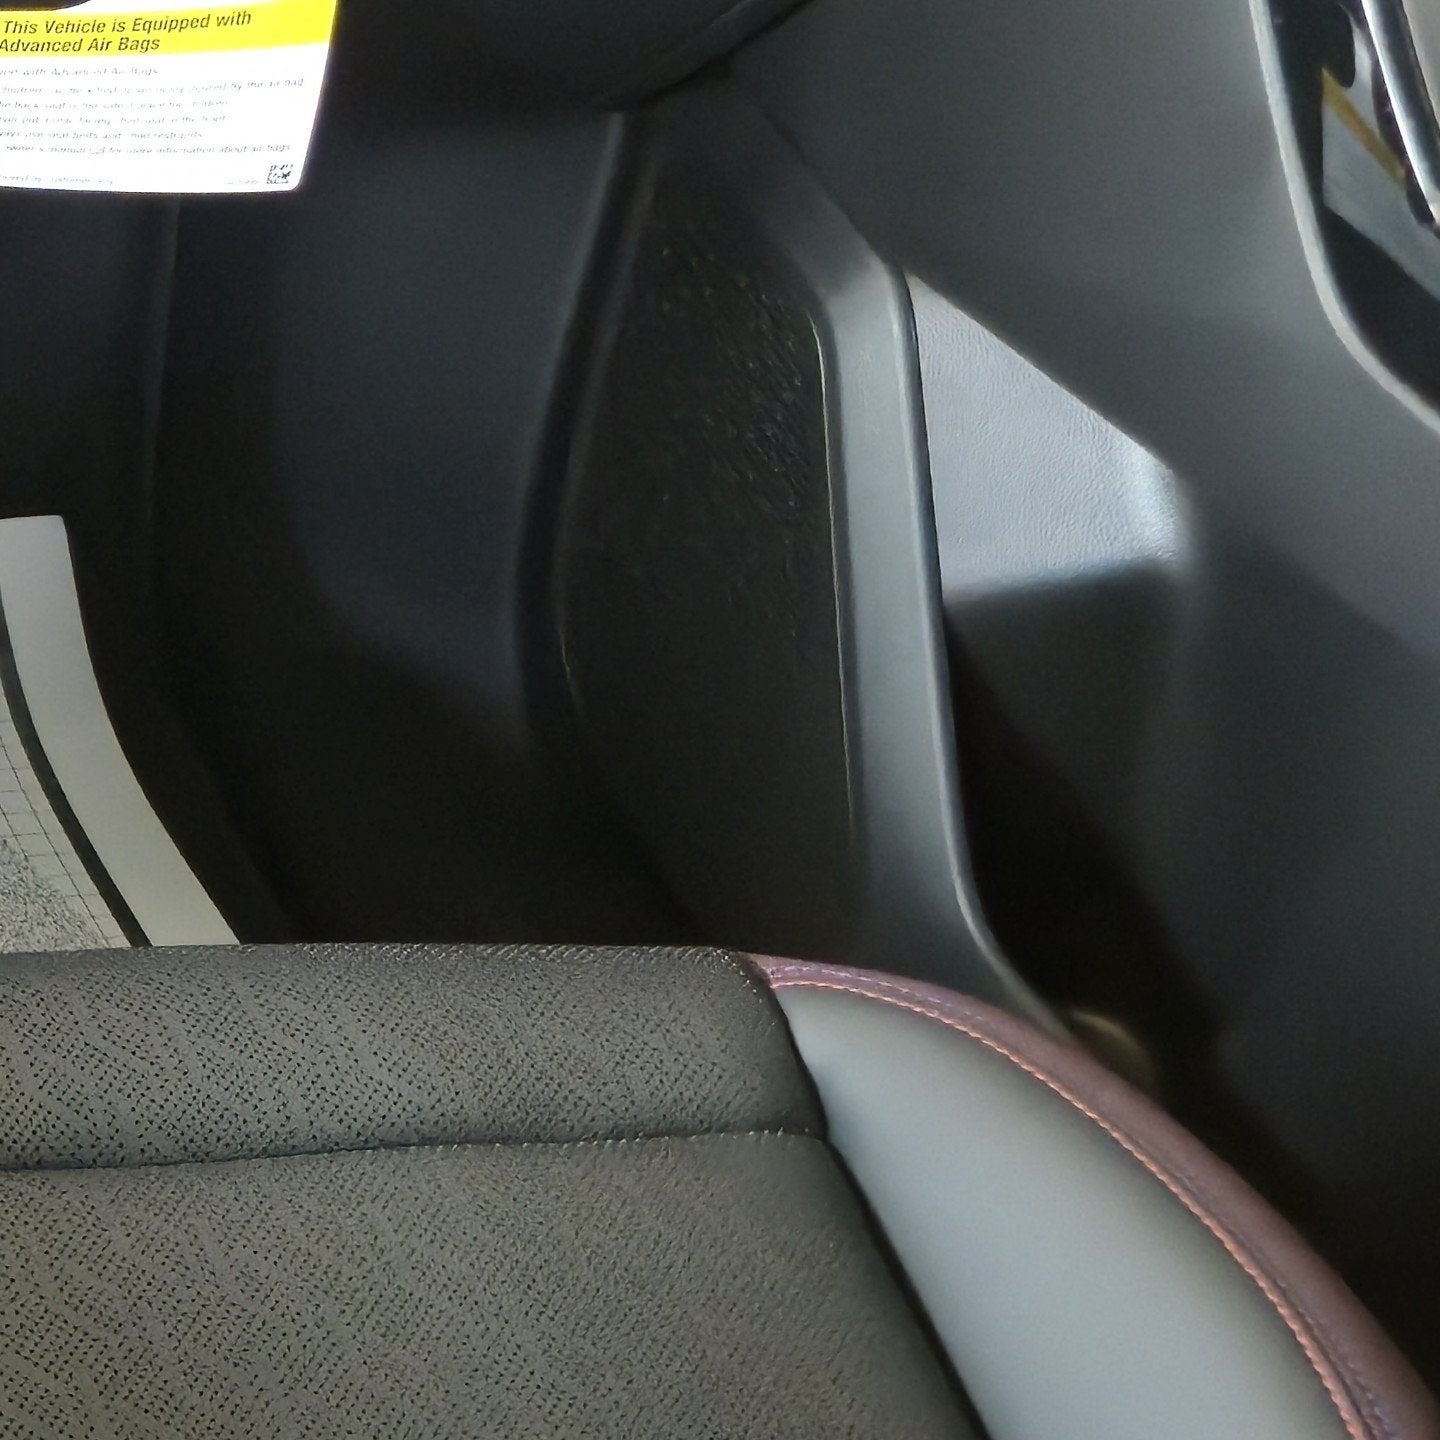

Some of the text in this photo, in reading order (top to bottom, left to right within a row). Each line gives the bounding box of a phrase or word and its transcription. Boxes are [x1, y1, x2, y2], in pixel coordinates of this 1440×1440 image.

[3, 11, 252, 35] This Vehicle is Equipped with
[87, 37, 112, 52] Air
[117, 37, 160, 54] Bags
